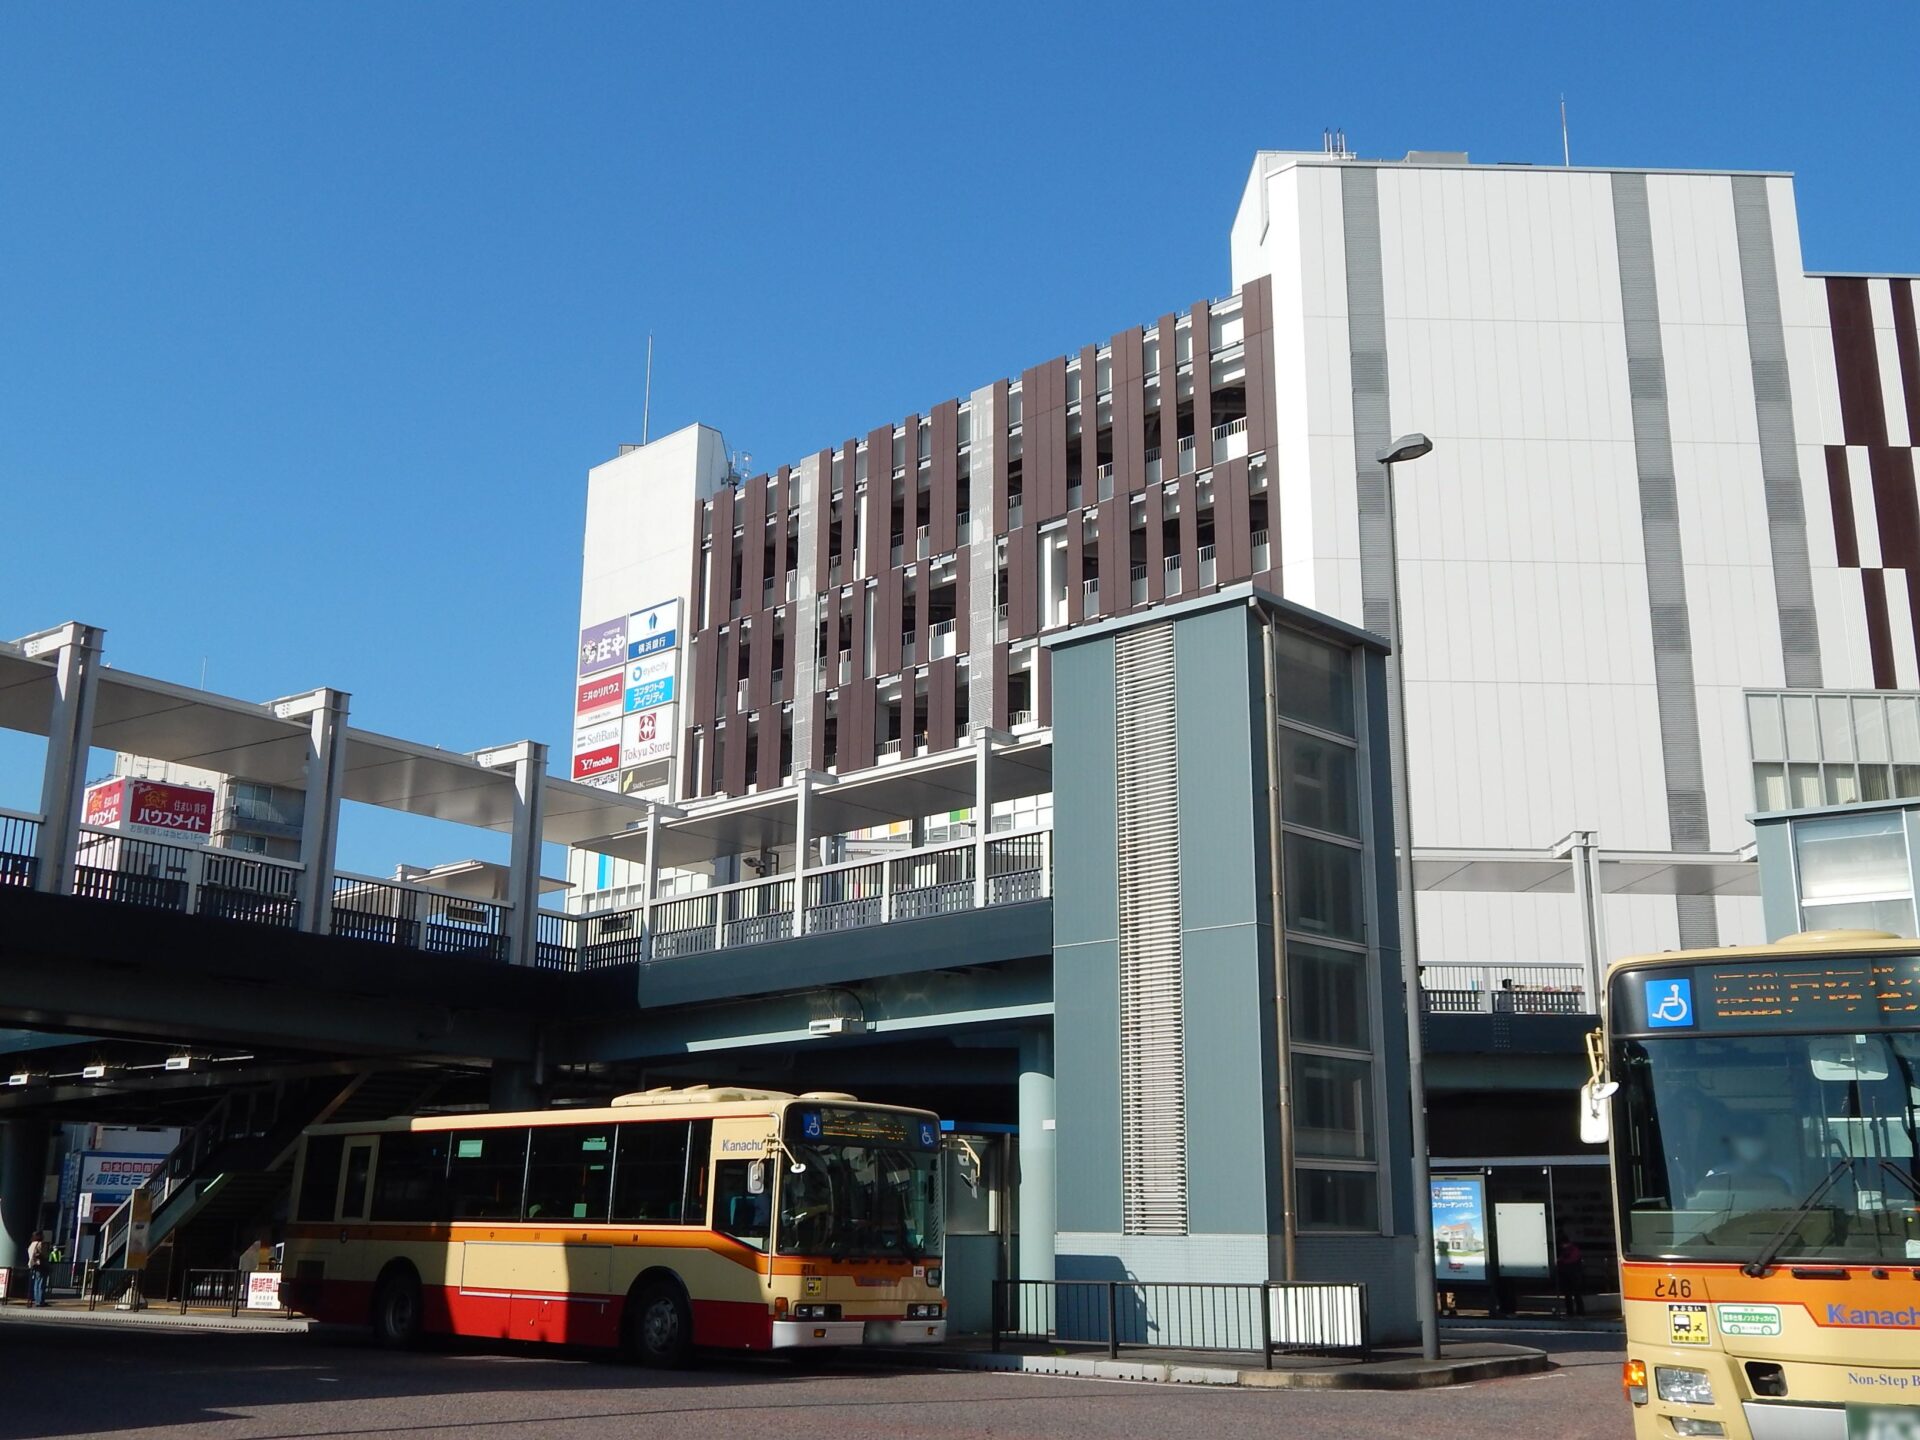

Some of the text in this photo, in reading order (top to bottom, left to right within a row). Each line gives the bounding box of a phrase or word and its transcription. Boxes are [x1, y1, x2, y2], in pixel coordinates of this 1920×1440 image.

[597, 634, 625, 663] 庄や
[638, 636, 666, 654] 横浜銀行
[582, 682, 620, 703] 三井のリハウス
[633, 680, 665, 697] コンタクトの
[633, 691, 665, 709] アイシティ
[587, 727, 619, 746] SoftBank
[624, 741, 671, 761] Tokyu Store
[137, 808, 206, 831] ハウスメイト
[722, 1138, 763, 1152] Kanachu
[95, 1174, 148, 1186] 創英ゼミ
[1432, 1201, 1474, 1209] スウェーデンハウス
[1654, 1278, 1692, 1298] と46
[1848, 1372, 1908, 1389] Non-Step
